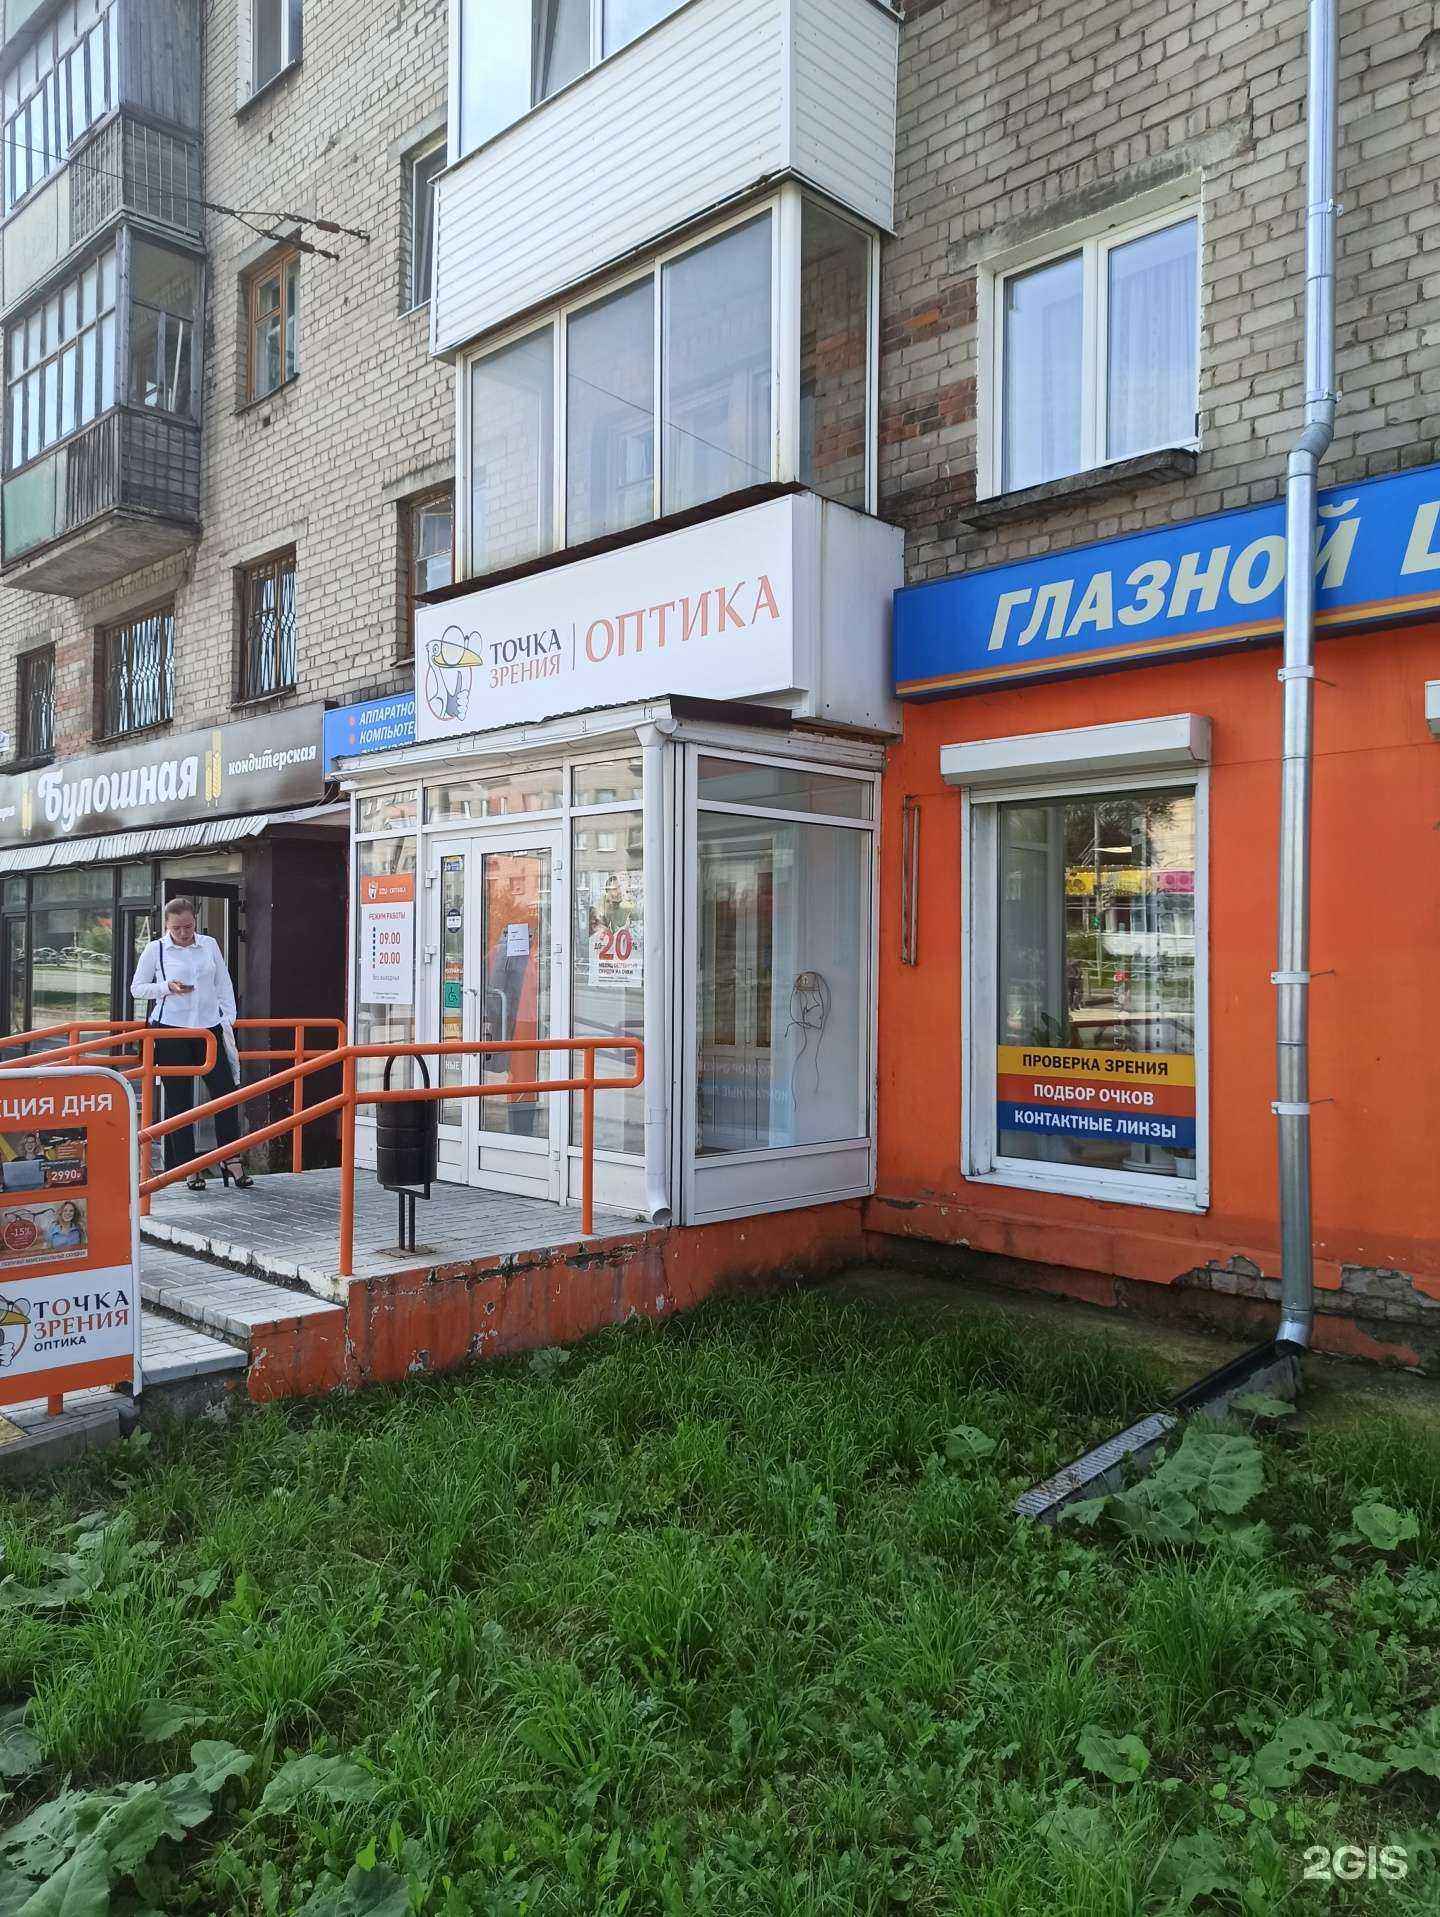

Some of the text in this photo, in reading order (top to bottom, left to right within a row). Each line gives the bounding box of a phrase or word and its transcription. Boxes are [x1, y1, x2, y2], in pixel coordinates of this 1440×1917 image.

[988, 497, 1360, 651] ГЛАЗНОЙ
[585, 574, 781, 663] ОПТИКА
[489, 628, 562, 665] ТОЧКА
[489, 653, 561, 689] ЗРЕНИЯ
[360, 701, 416, 725] АППАРАТНО
[360, 721, 416, 744] КОМПЬЮТЕ
[228, 745, 317, 777] кондитерская
[38, 755, 199, 832] Булошная
[380, 932, 400, 944] 09.00
[598, 928, 633, 960] 20
[379, 952, 400, 964] 20.00
[1022, 1053, 1169, 1076] ПРОВЕРКА ЗРЕНИЯ
[0, 1093, 112, 1120] ЦИЯ ДНЯ
[1033, 1083, 1154, 1106] ПОДБОР ОЧКОВ
[1014, 1110, 1176, 1139] КОНТАКТНЫЕ ЛИНЗЫ
[34, 1290, 129, 1318] ТОЧКА
[34, 1308, 129, 1340] ЗРЕНИЯ
[34, 1336, 87, 1352] ОПТИКА
